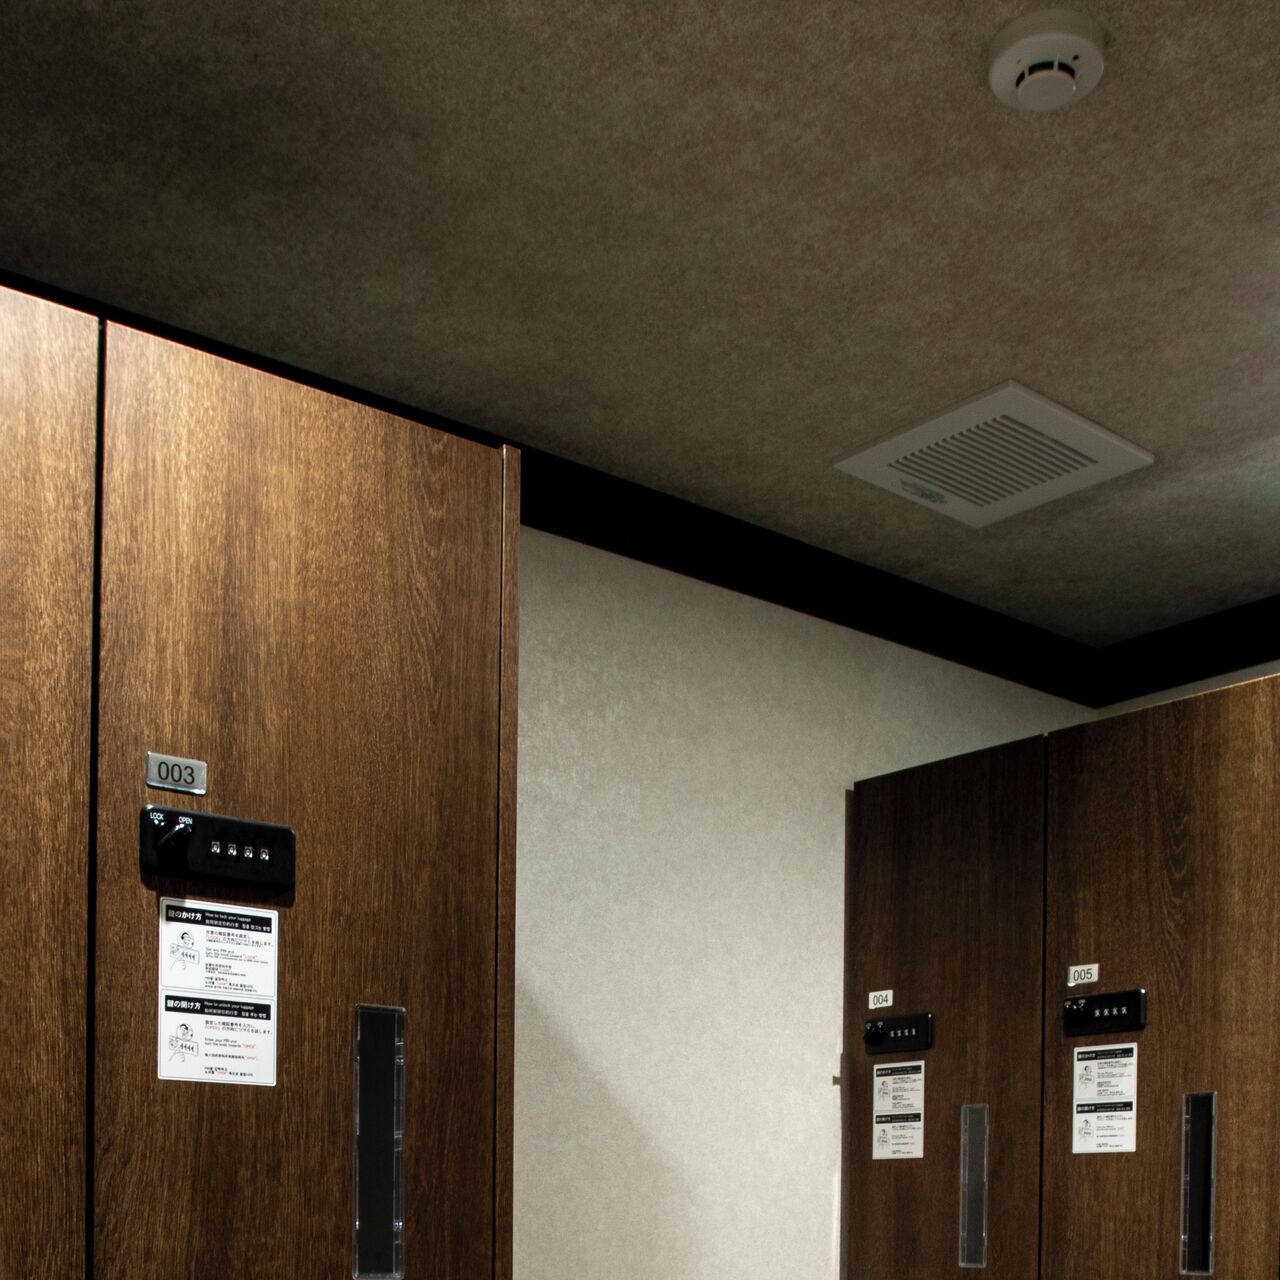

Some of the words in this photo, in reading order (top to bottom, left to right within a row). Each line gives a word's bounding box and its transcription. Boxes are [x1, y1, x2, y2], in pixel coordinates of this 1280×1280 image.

[158, 761, 195, 785] 003
[150, 812, 164, 820] LOCK
[179, 816, 193, 825] OPEN
[1073, 968, 1093, 982] 005
[873, 993, 889, 1006] 004
